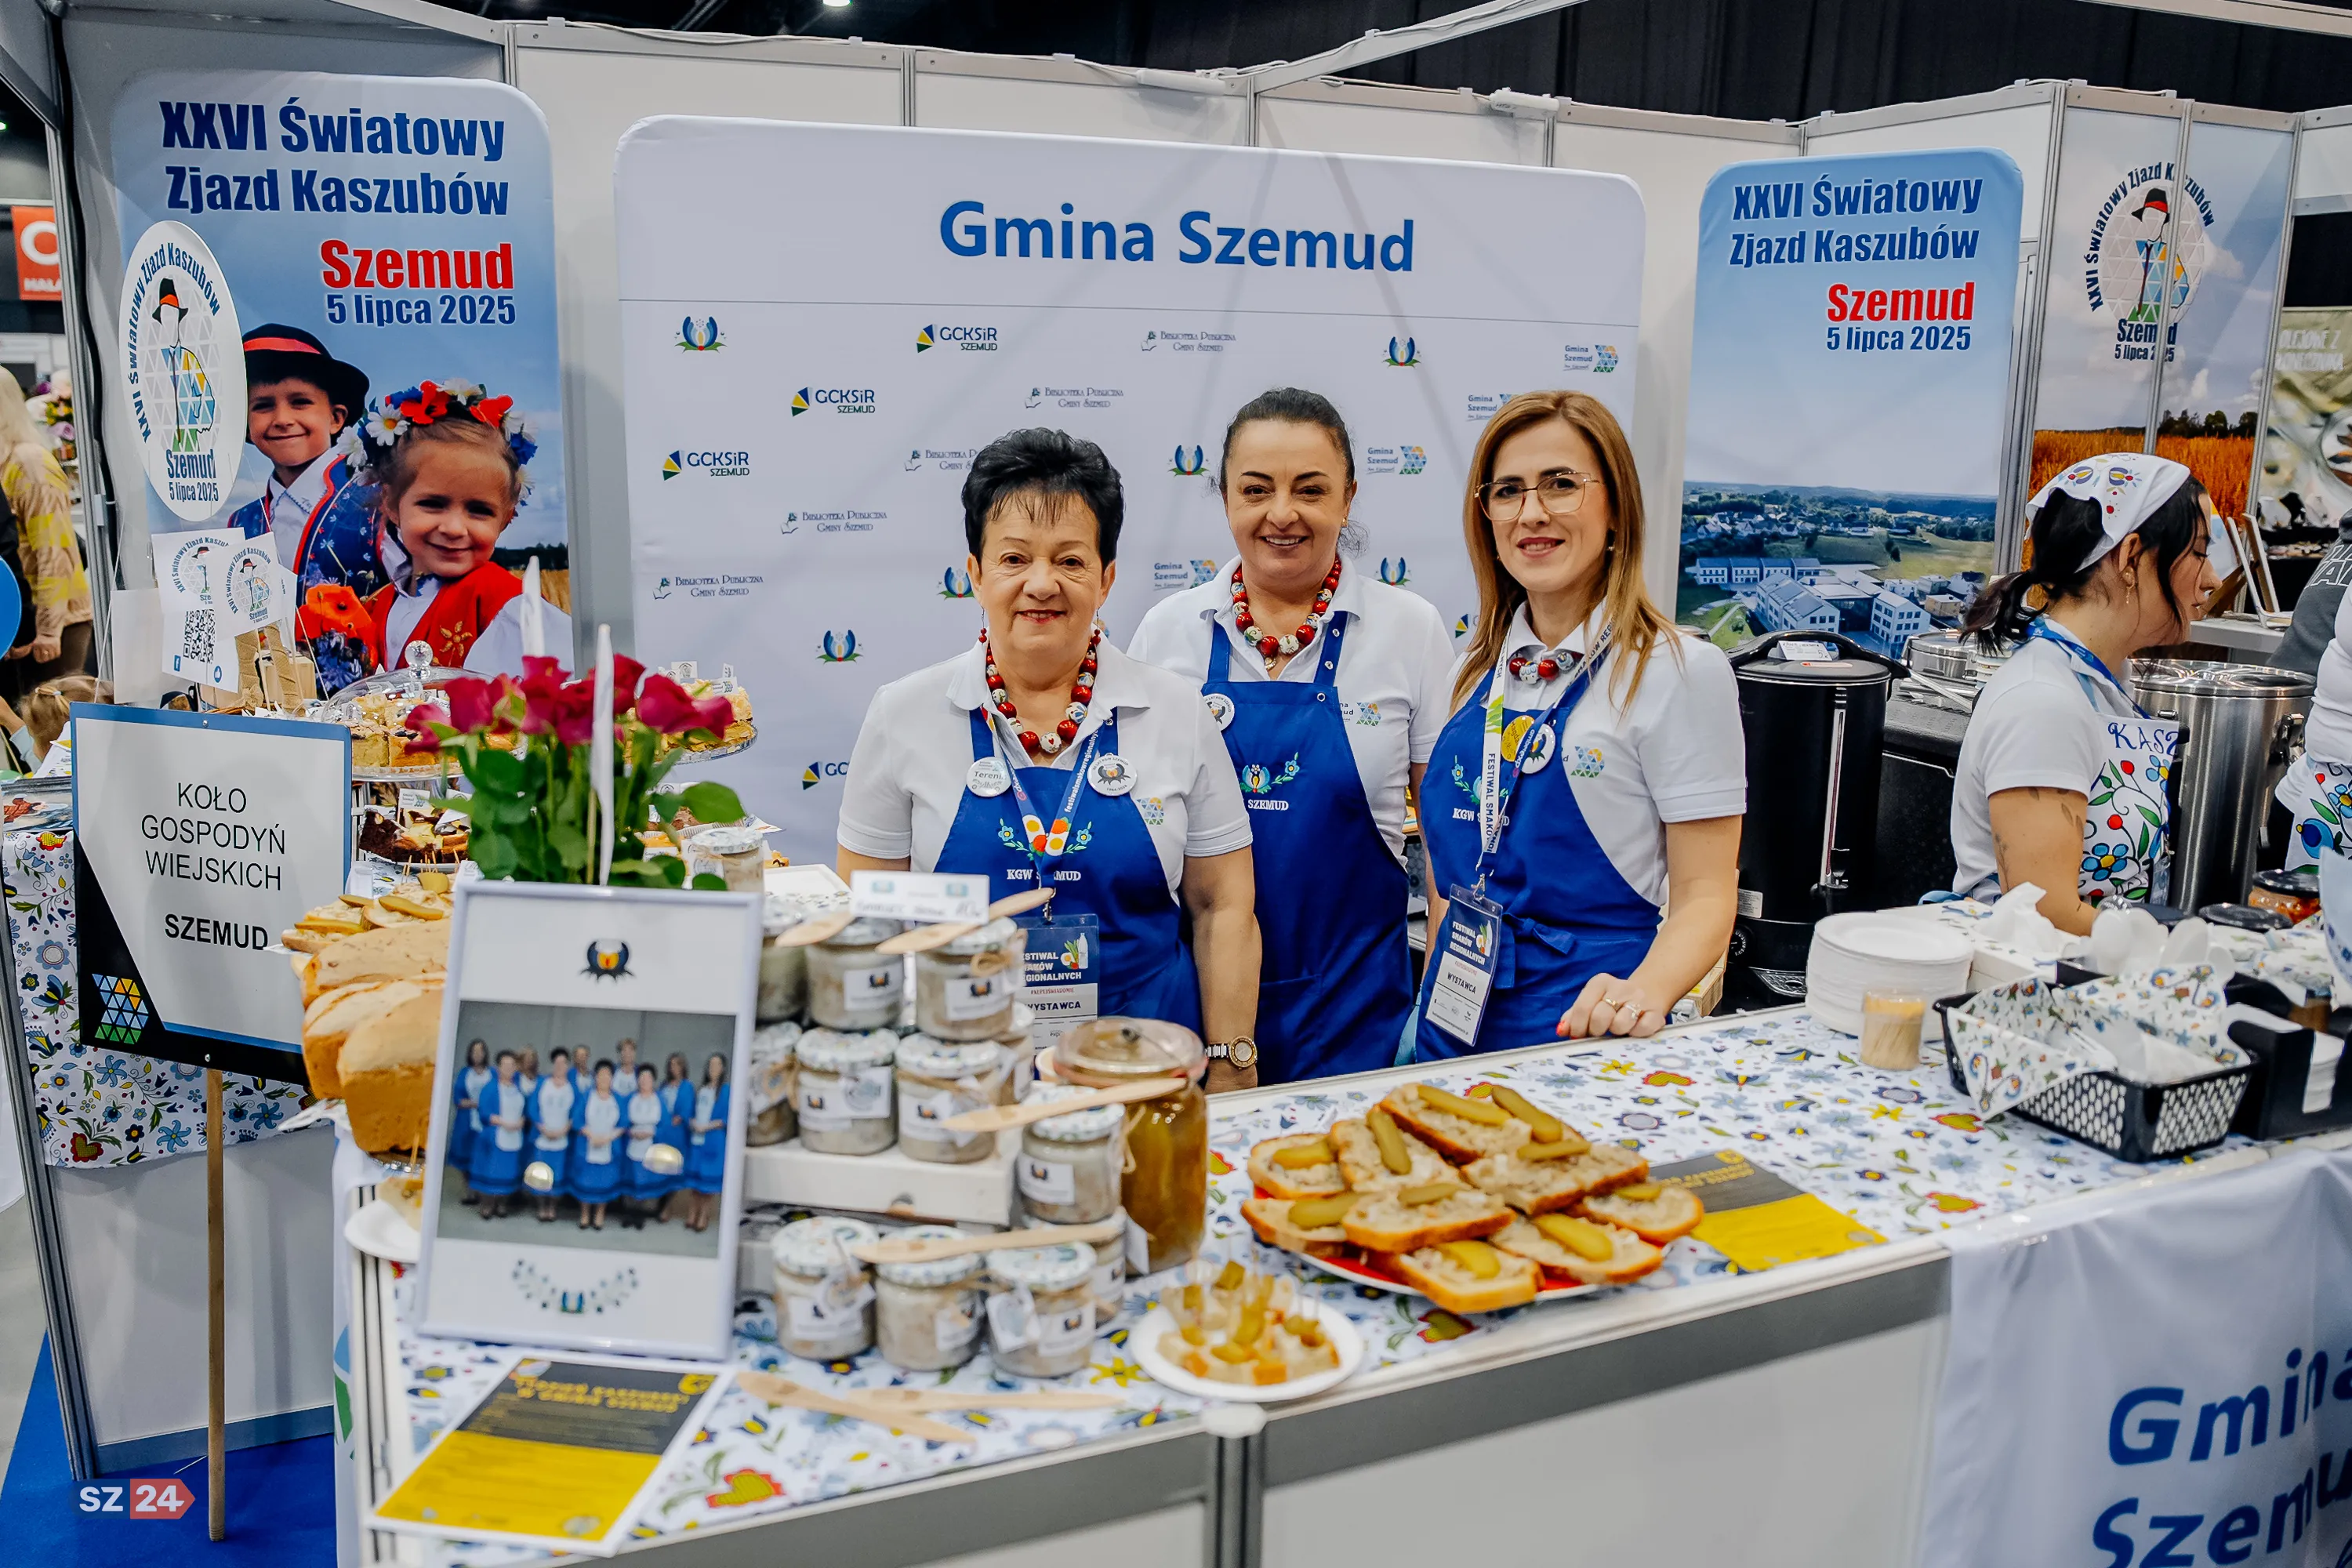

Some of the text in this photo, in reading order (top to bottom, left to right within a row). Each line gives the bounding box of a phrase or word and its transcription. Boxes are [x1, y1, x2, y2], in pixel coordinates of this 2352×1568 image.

[159, 96, 506, 162] XXVI Światowy
[164, 165, 510, 216] Zjazd Kaszubów
[1733, 173, 1984, 221] XXVI Światowy
[940, 201, 1414, 272] Gmina Szemud
[1730, 222, 1980, 268] Zjazd Kaszubów
[2083, 161, 2215, 312] XXVI Światowy Zjazd Kzubów
[320, 238, 514, 290] Szemud
[327, 294, 516, 328] 5 lipca 2025
[1827, 281, 1976, 323] Szemud
[127, 242, 221, 443] XXVI Światowy Zjazd Kaszubów
[940, 326, 997, 341] GCKSiR
[1827, 325, 1972, 354] 5 lipca 2025
[2117, 318, 2178, 345] Szemd
[2114, 343, 2122, 360] 5
[2123, 343, 2149, 361] lipca
[815, 389, 875, 404] GCKSiR
[166, 448, 217, 479] Szemud
[687, 452, 750, 467] GCKSiR
[710, 468, 750, 477] SZEMUD
[169, 481, 219, 503] 5 lipca 2025
[177, 782, 248, 814] KOŁO
[1247, 799, 1289, 811] SZEMUD
[1453, 808, 1475, 822] KGW
[140, 814, 286, 856] GOSPODYŃ
[144, 850, 282, 891] WIEJSKICH
[1007, 869, 1033, 880] KGW
[165, 913, 269, 952] SZEMUD
[1447, 971, 1476, 995] WYSTAWCA
